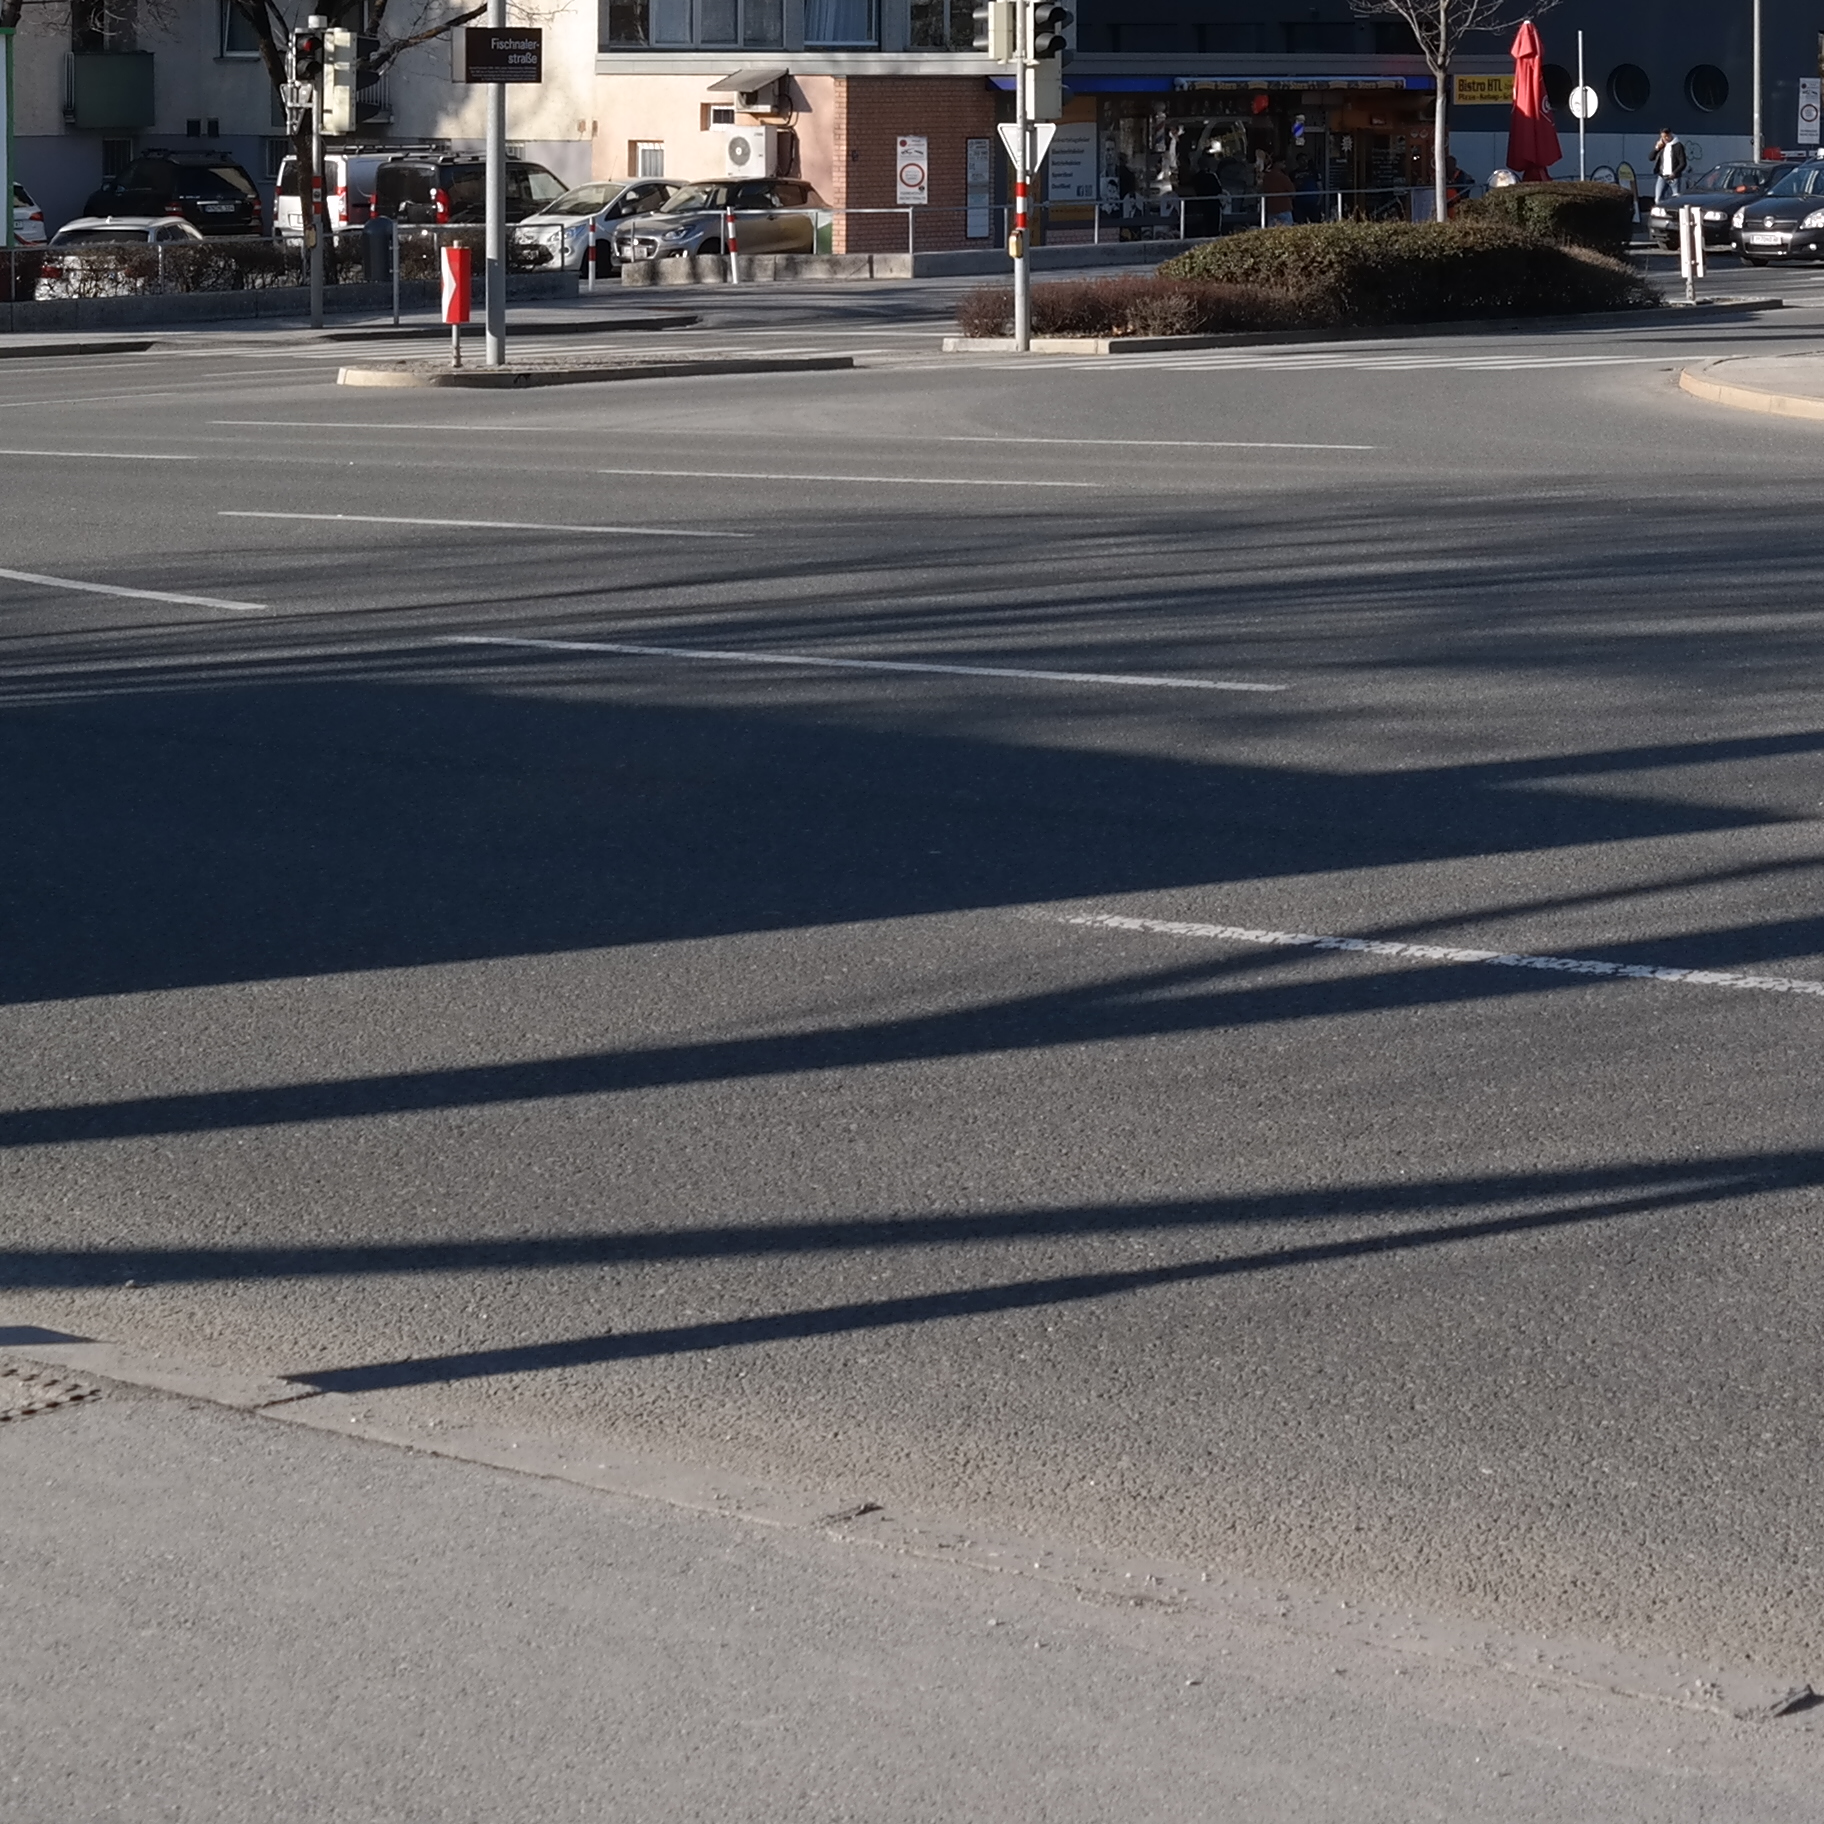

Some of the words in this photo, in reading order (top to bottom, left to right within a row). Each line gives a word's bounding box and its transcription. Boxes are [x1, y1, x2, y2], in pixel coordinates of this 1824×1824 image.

[491, 38, 540, 50] Fischnaler-
[508, 52, 538, 64] straße
[1458, 79, 1486, 92] Bistro
